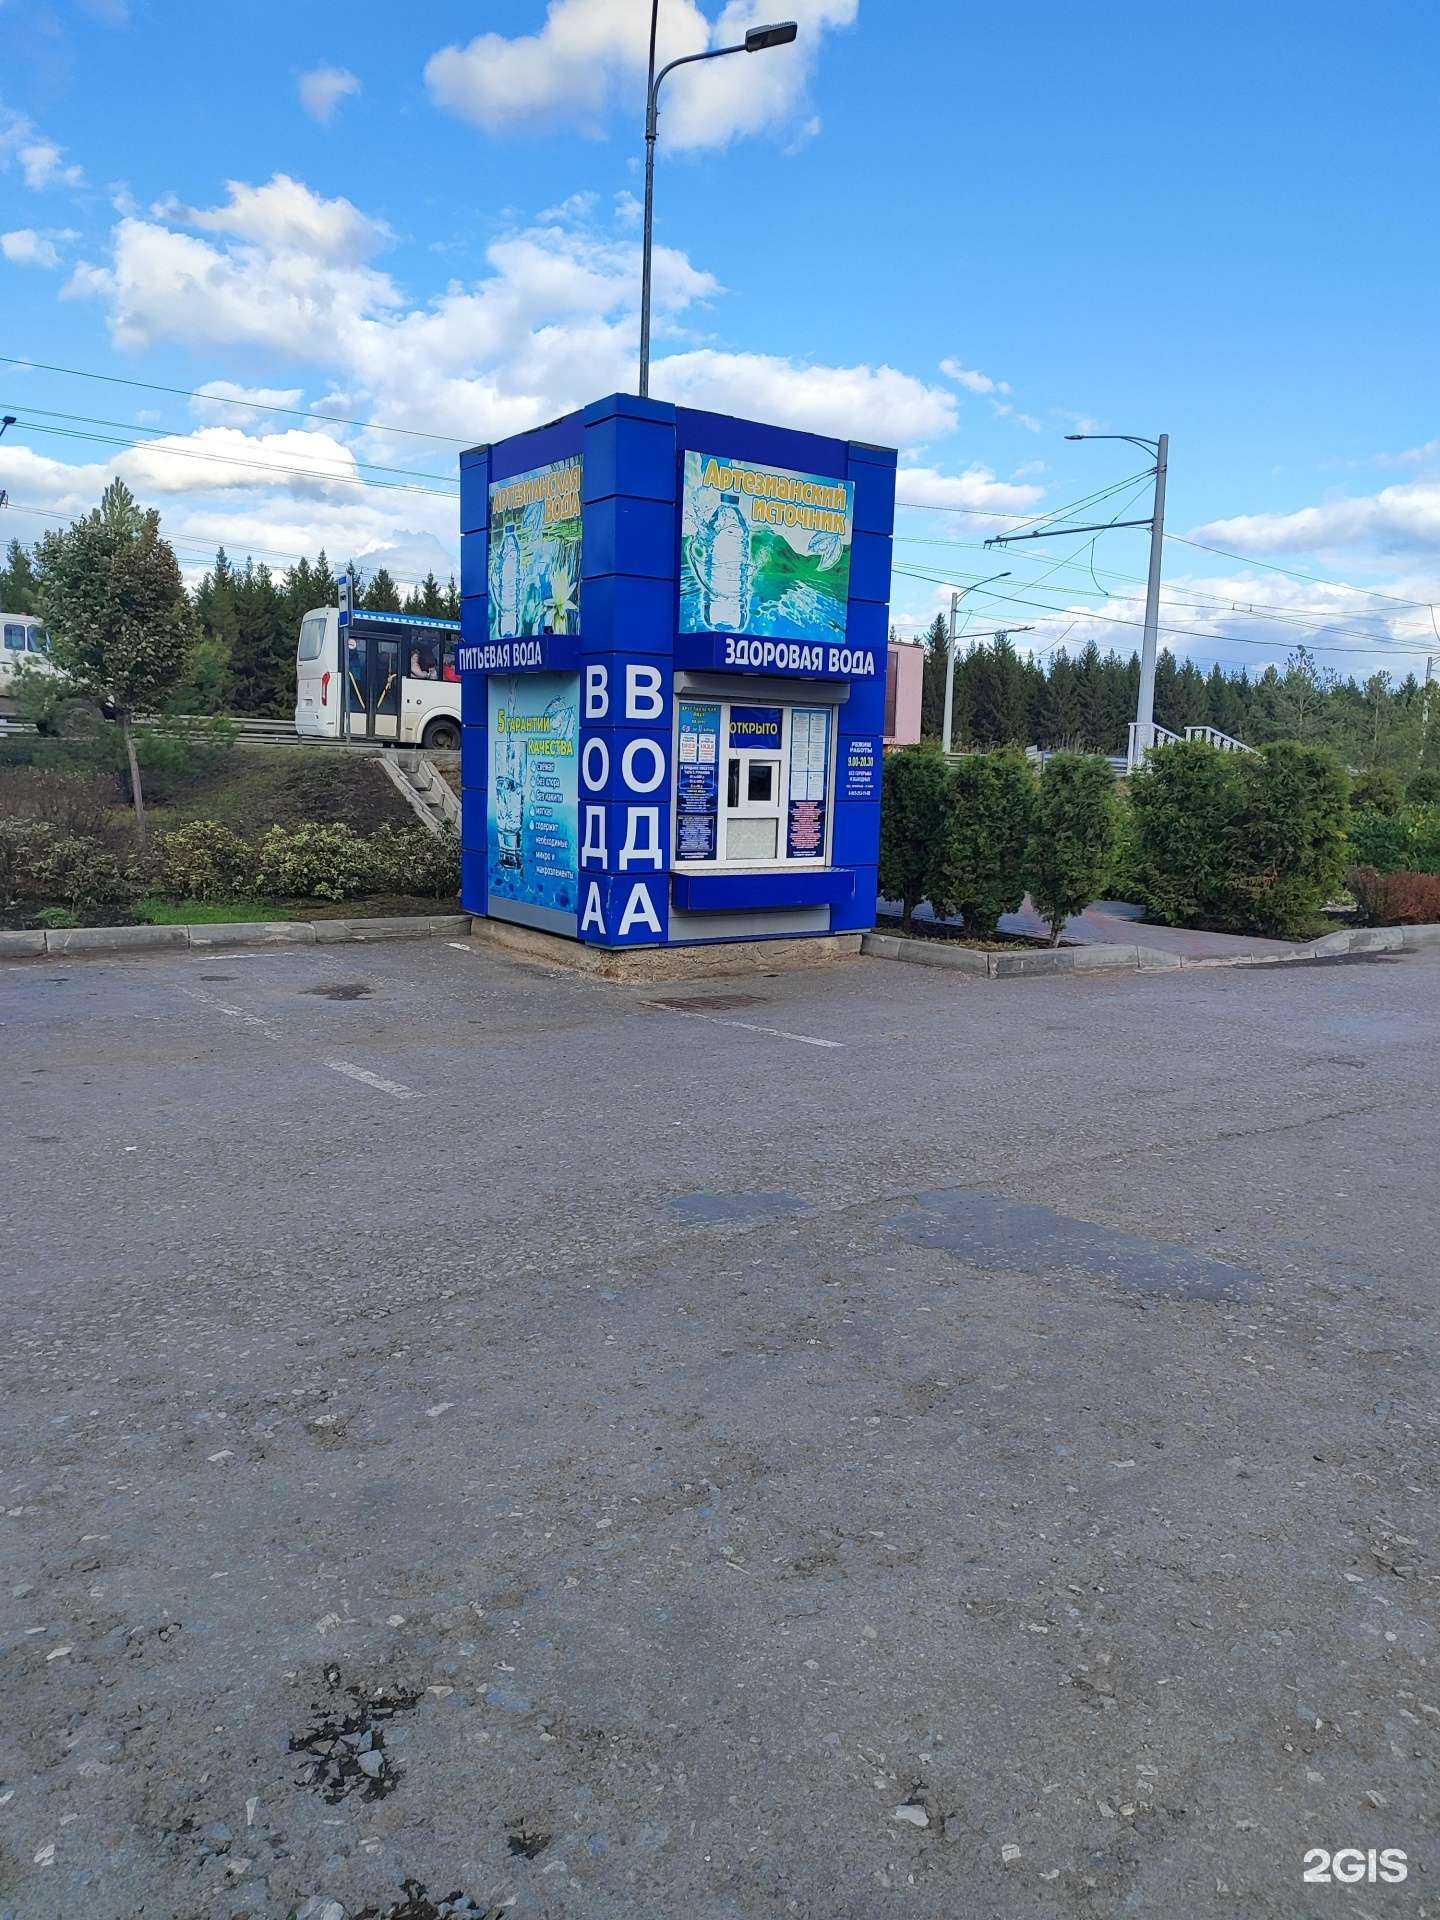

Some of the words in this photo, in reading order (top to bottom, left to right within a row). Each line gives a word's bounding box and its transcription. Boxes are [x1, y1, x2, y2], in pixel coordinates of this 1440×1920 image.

[544, 491, 581, 524] ВОДА
[459, 644, 510, 671] ПИТЬЕВАЯ
[513, 641, 542, 666] ВОДА
[725, 638, 823, 671] ЗДОРОВАЯ
[828, 648, 875, 675] ВОДА
[497, 708, 506, 733] 5
[730, 722, 778, 735] ОТКРЫТО
[528, 739, 574, 757] КАЧЕСТВА
